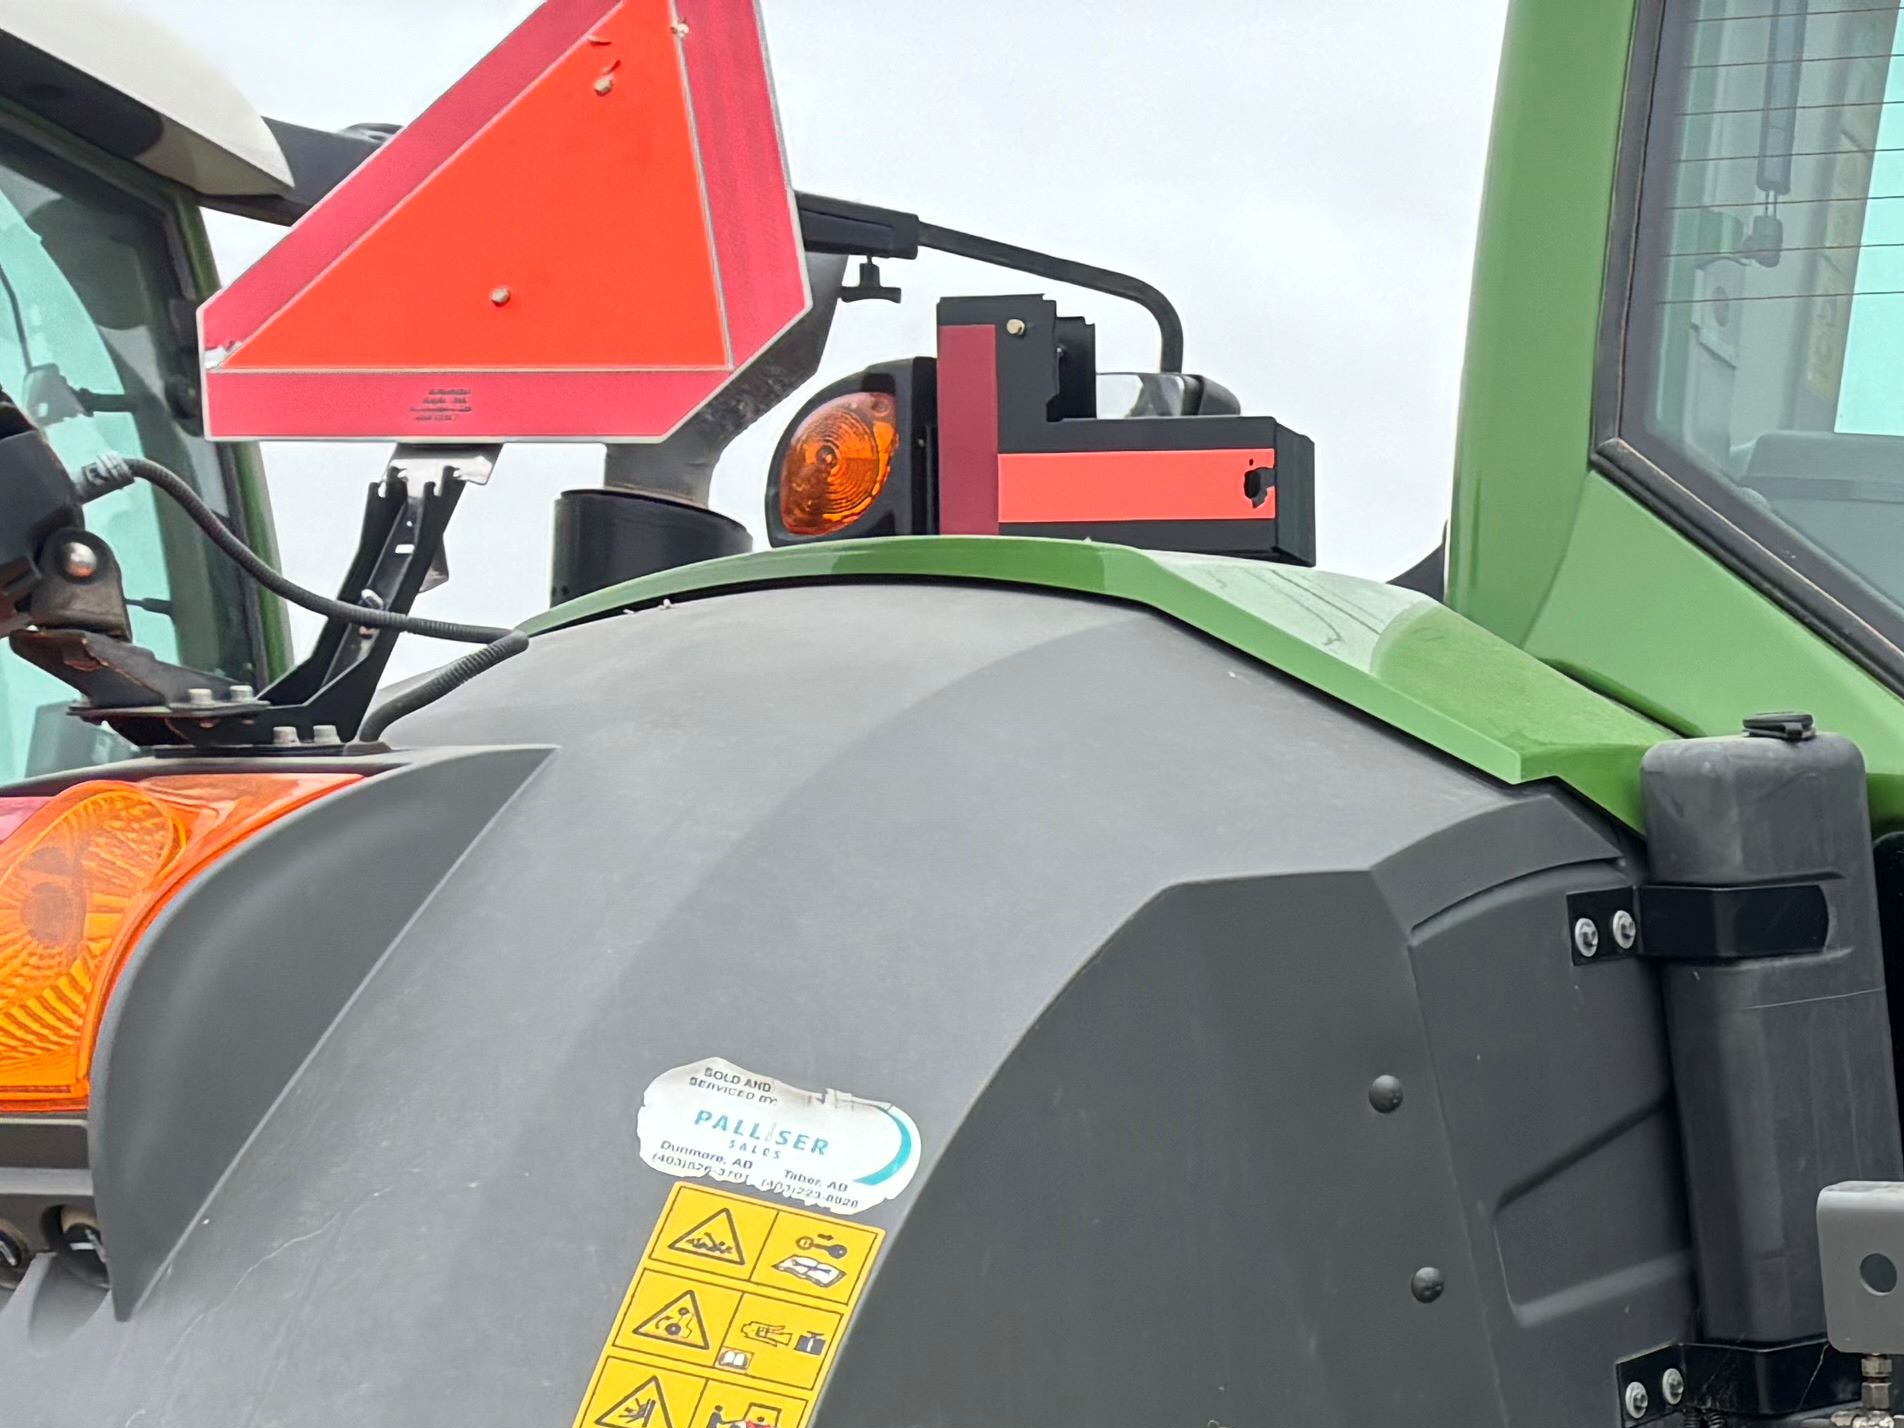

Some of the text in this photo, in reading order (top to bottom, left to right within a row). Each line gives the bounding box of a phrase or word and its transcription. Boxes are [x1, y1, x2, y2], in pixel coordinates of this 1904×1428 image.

[689, 1077, 755, 1100] SERVICED
[704, 1067, 771, 1093] SOLD AND
[694, 1109, 829, 1155] PALLISER
[729, 1139, 781, 1159] SALES
